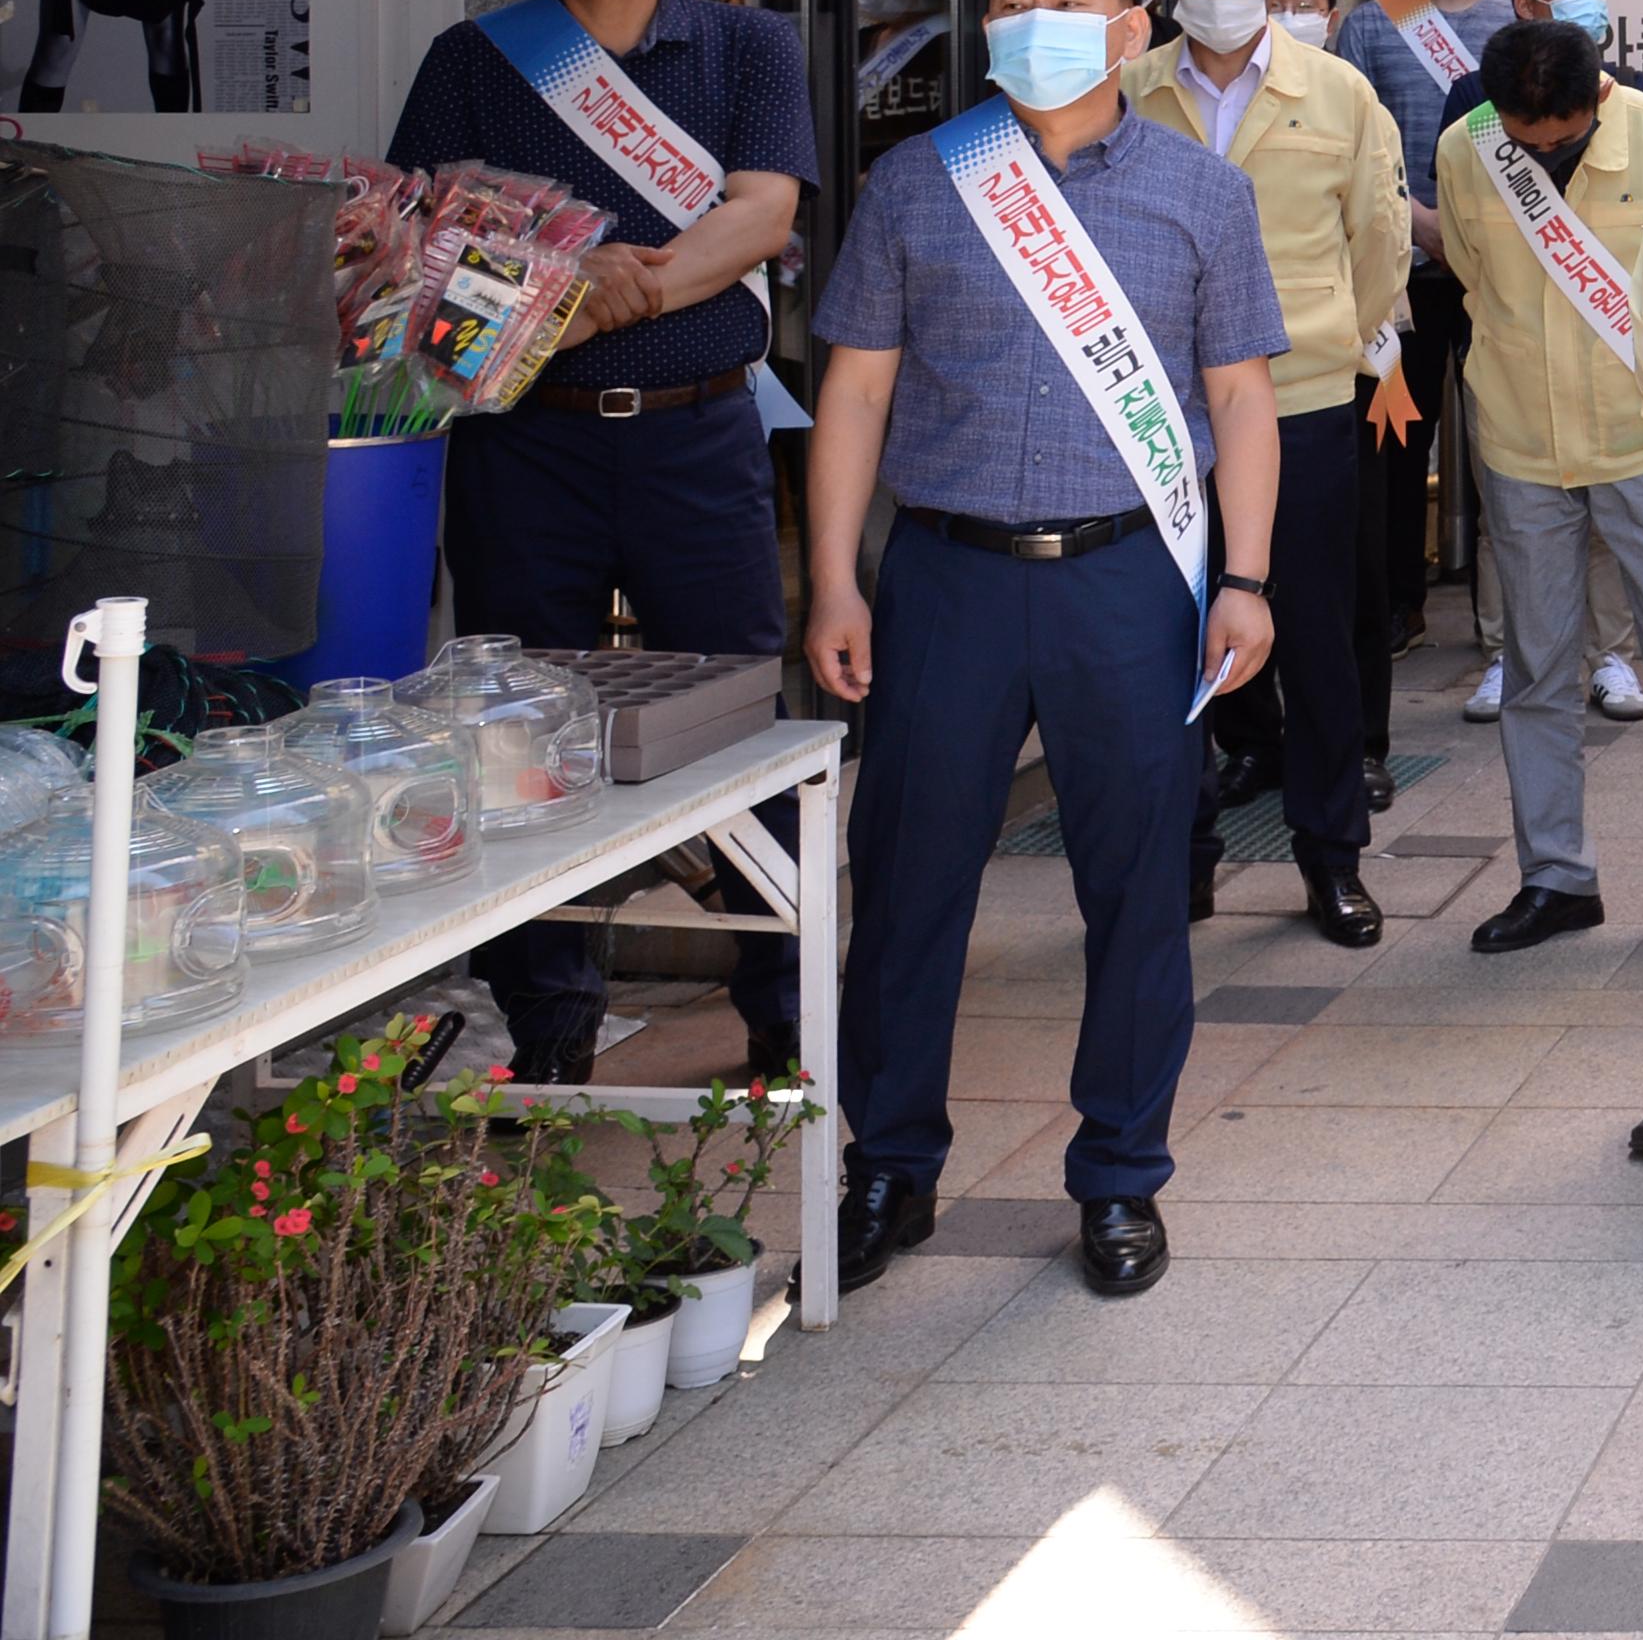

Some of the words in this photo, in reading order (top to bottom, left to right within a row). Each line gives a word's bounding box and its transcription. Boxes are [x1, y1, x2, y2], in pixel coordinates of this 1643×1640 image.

[570, 75, 714, 211] 긴급재난지원금
[1494, 139, 1551, 223] 오늘은
[1535, 214, 1634, 336] 재난지원금
[978, 161, 1113, 337] 긴급재난지원금
[1081, 326, 1145, 393] 받고
[1114, 378, 1184, 487] 전통시장
[1164, 475, 1198, 541] 가요
